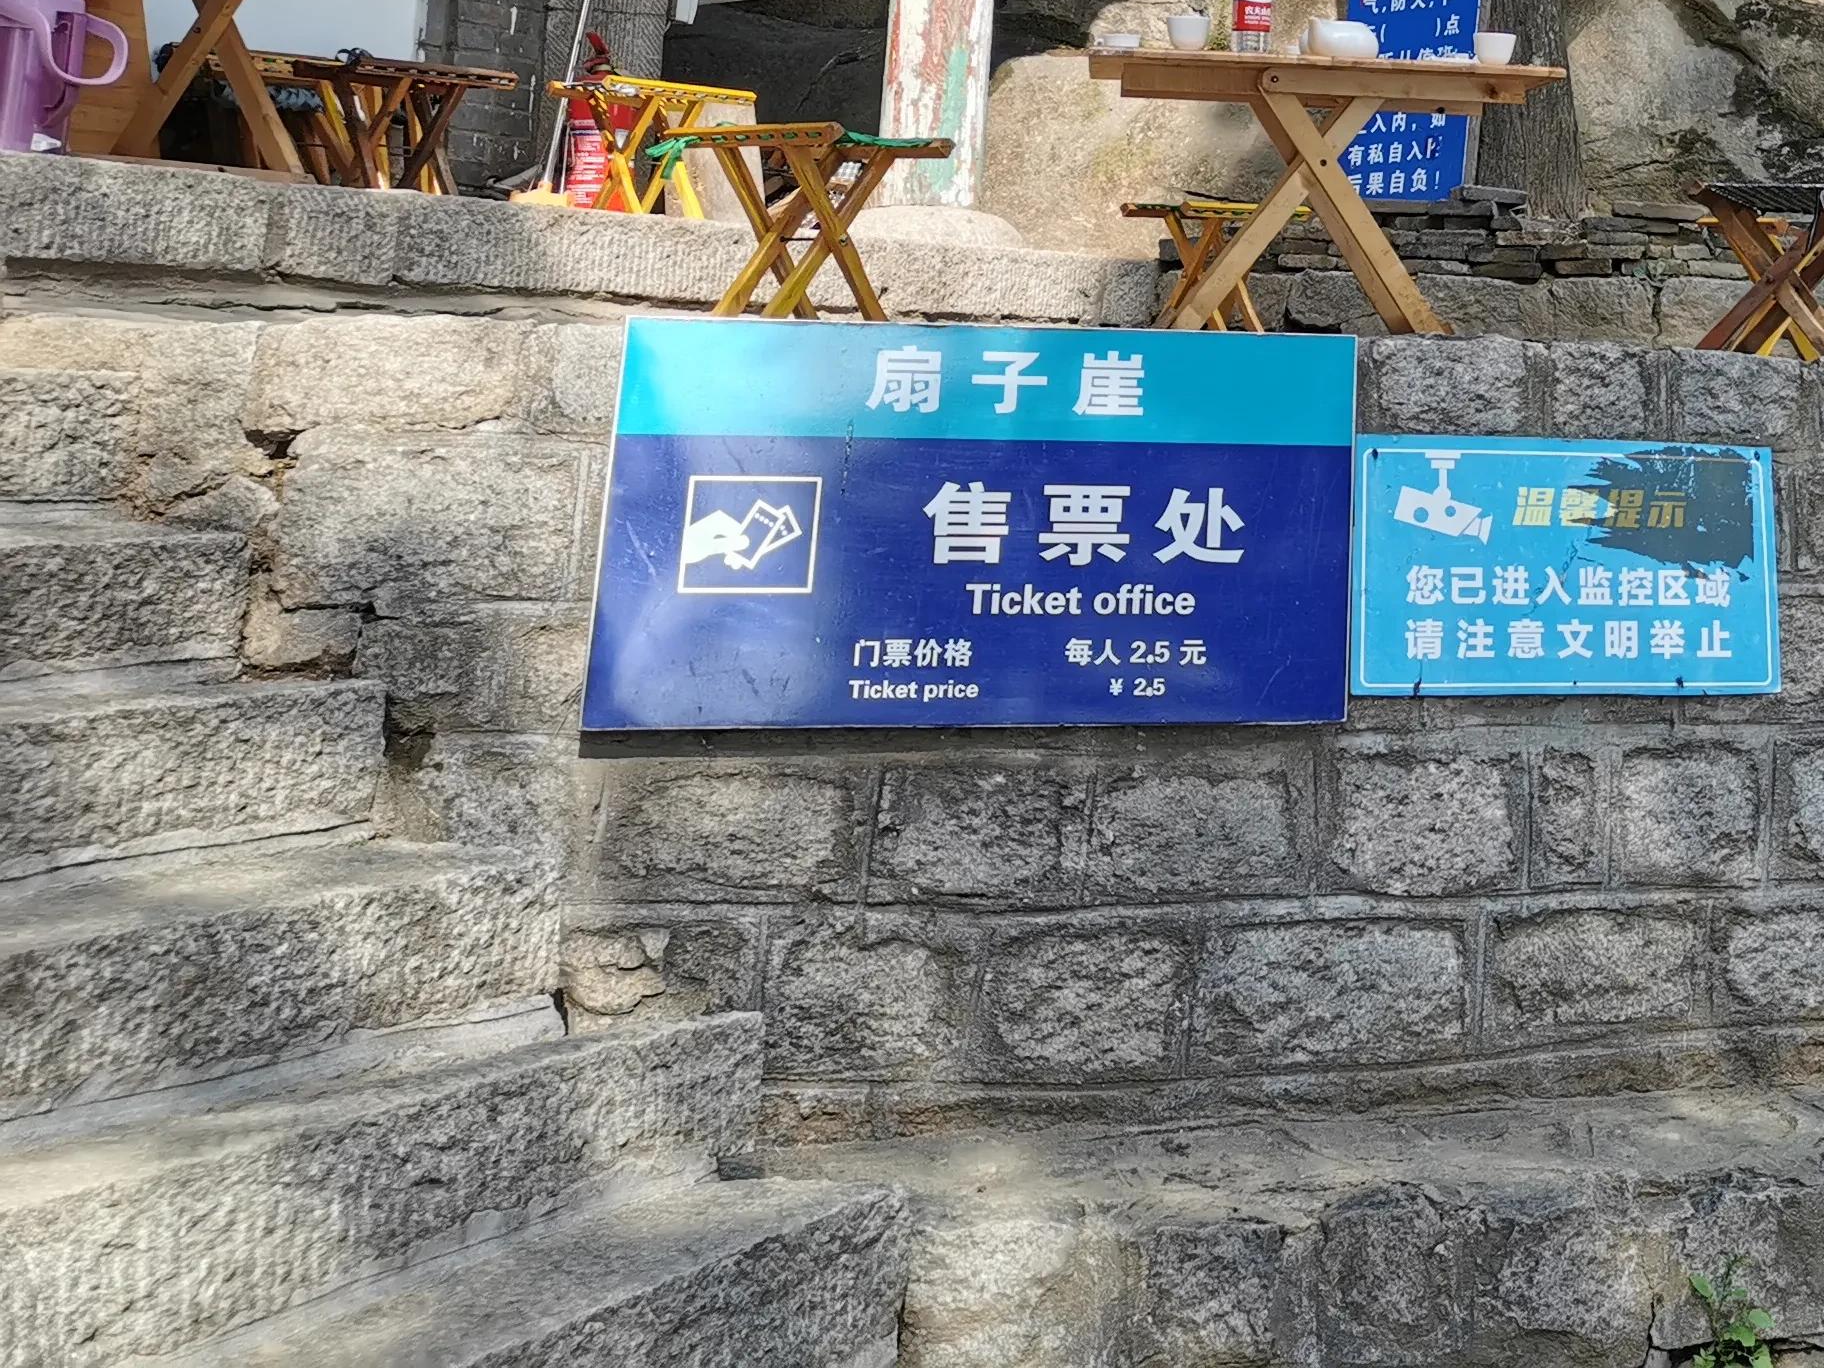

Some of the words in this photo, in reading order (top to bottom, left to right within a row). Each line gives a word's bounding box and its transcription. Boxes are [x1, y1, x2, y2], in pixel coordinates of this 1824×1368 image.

[1358, 111, 1446, 135] 入内，如
[865, 345, 1145, 416] 扇子崖
[922, 481, 1246, 566] 售票处
[1511, 486, 1688, 529] 温馨提示
[965, 583, 1081, 616] Ticket
[1093, 583, 1196, 616] office
[1405, 565, 1732, 608] 您已进入监控区域
[852, 638, 973, 669] 门票价格
[1064, 637, 1122, 668] 每人
[1129, 640, 1171, 665] 2.5
[1178, 639, 1208, 667] 元
[1404, 618, 1733, 661] 请注意文明举止
[848, 679, 918, 700] Ticket
[923, 679, 980, 703] price
[1132, 678, 1166, 698] 2.5
